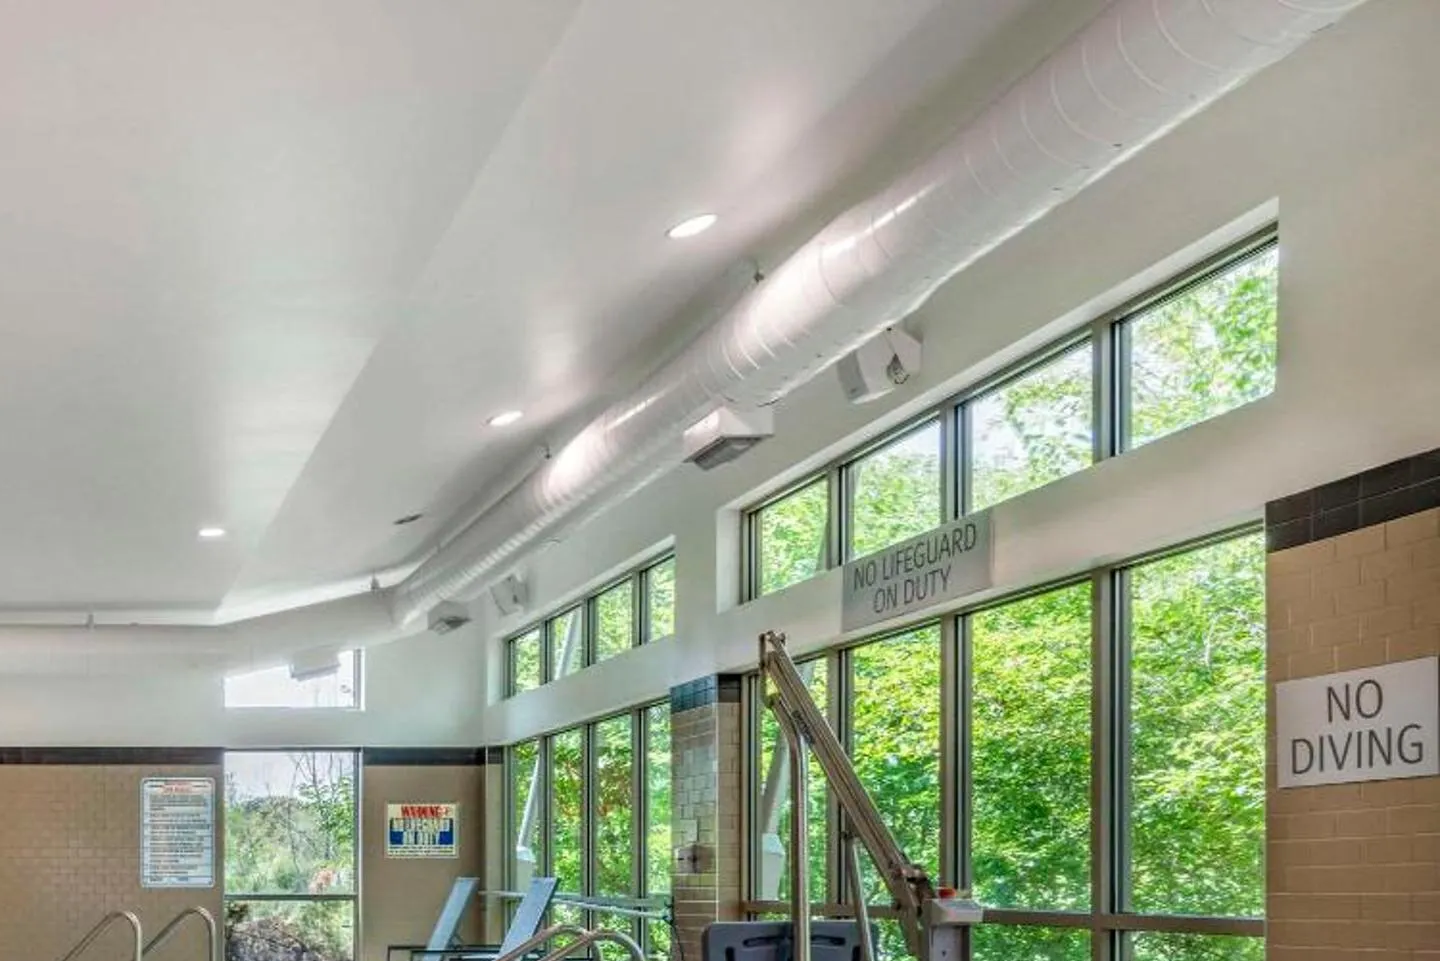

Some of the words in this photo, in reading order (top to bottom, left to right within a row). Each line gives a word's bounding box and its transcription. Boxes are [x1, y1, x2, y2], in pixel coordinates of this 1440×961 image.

[853, 561, 877, 592] NO
[882, 523, 977, 581] LIFEGUARD
[873, 583, 898, 614] ON
[903, 565, 952, 606] DUTY
[1326, 679, 1384, 723] NO
[1291, 723, 1424, 775] DIVING
